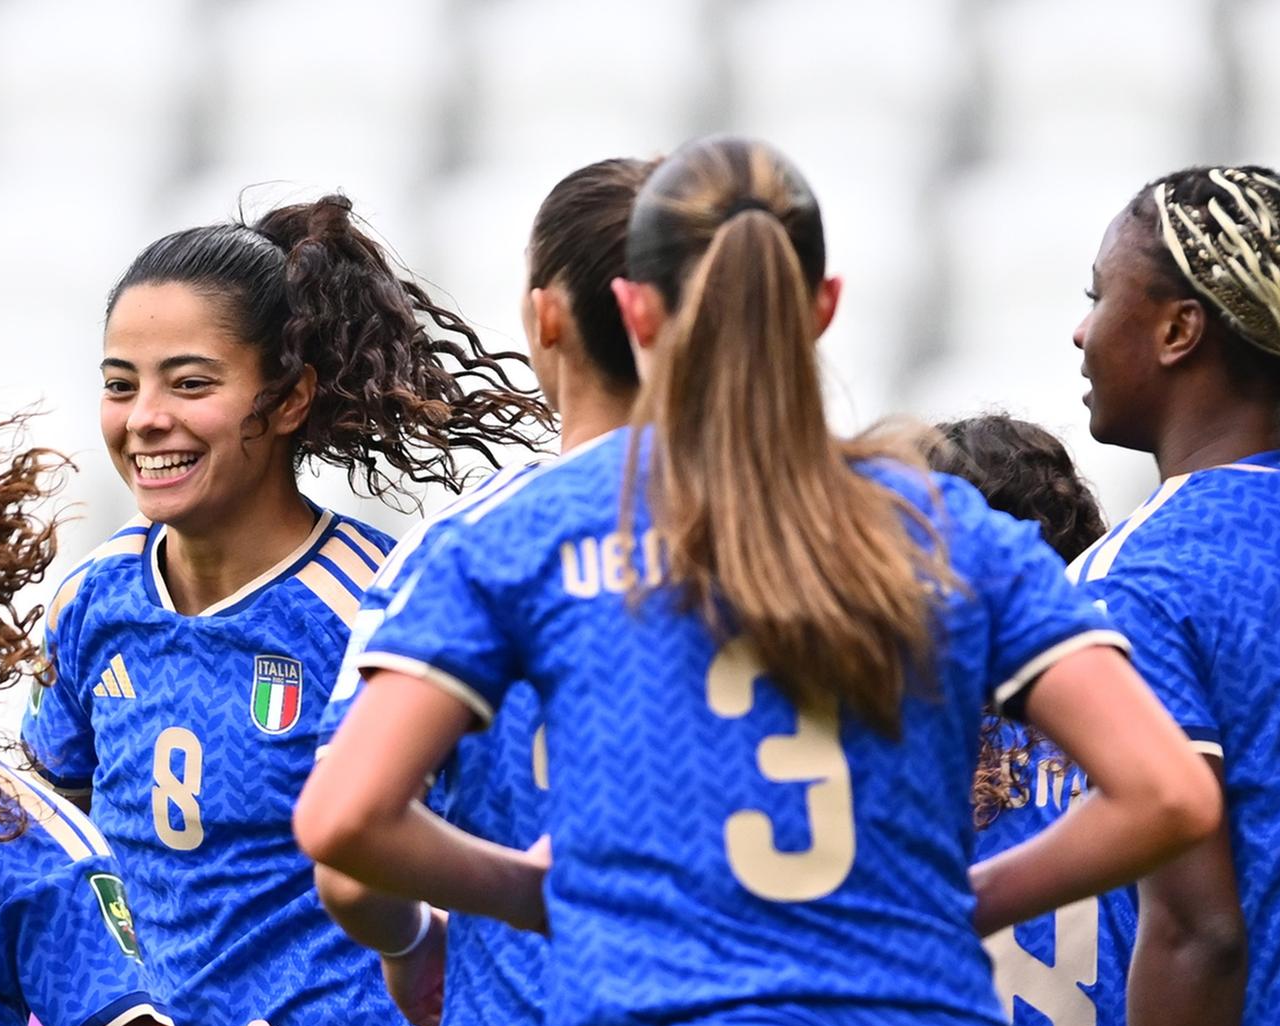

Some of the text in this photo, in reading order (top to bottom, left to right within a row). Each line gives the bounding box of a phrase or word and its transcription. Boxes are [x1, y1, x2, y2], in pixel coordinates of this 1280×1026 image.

[258, 660, 298, 679] ITALIA
[151, 727, 205, 851] 8
[706, 637, 856, 903] 3
